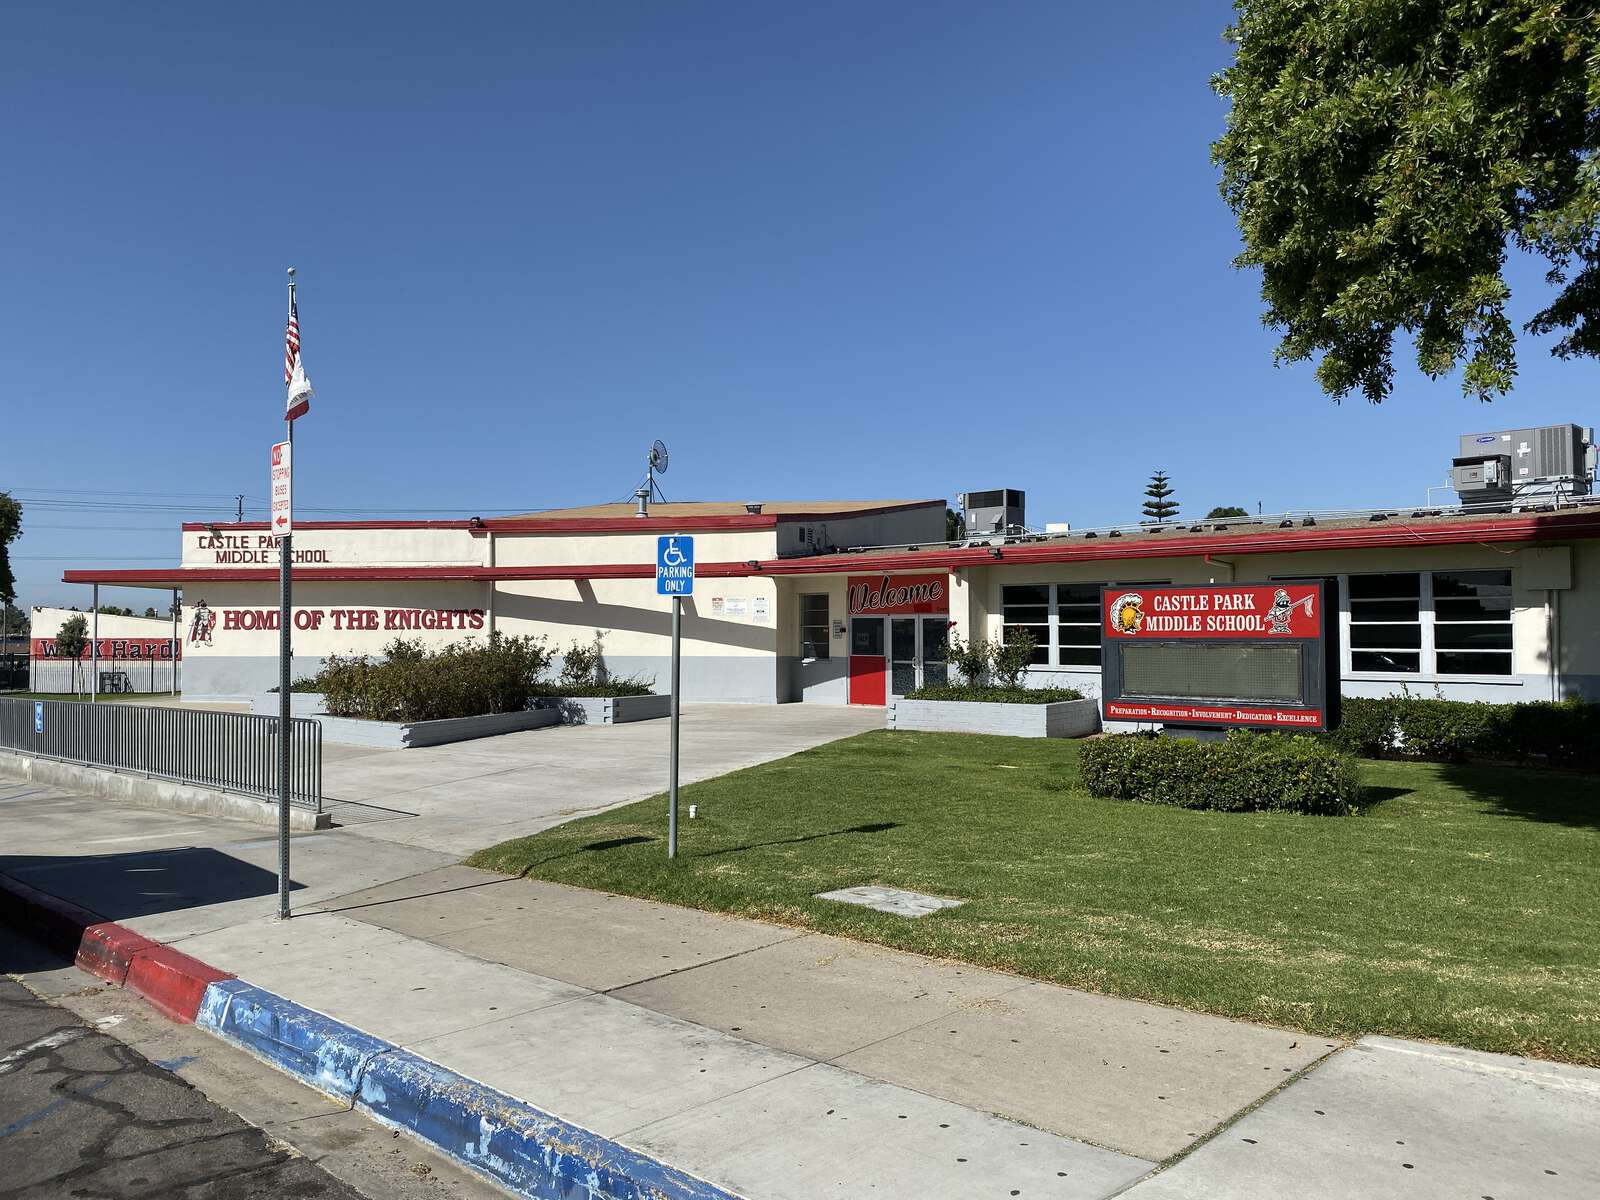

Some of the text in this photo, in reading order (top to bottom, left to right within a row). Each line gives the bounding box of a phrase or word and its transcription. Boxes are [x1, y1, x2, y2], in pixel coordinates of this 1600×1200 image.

[275, 484, 287, 496] BUSES
[198, 535, 283, 549] CASTLE PAR
[215, 550, 269, 563] MIDDLE
[658, 566, 692, 578] PARKING
[665, 579, 686, 592] ONLY
[849, 575, 943, 616] Welcome
[1153, 593, 1255, 611] CASTLE PARK
[294, 609, 325, 630] OF
[330, 609, 380, 630] THE
[384, 608, 485, 630] KNIGHTS
[1145, 615, 1265, 631] MIDDLE SCHOOL
